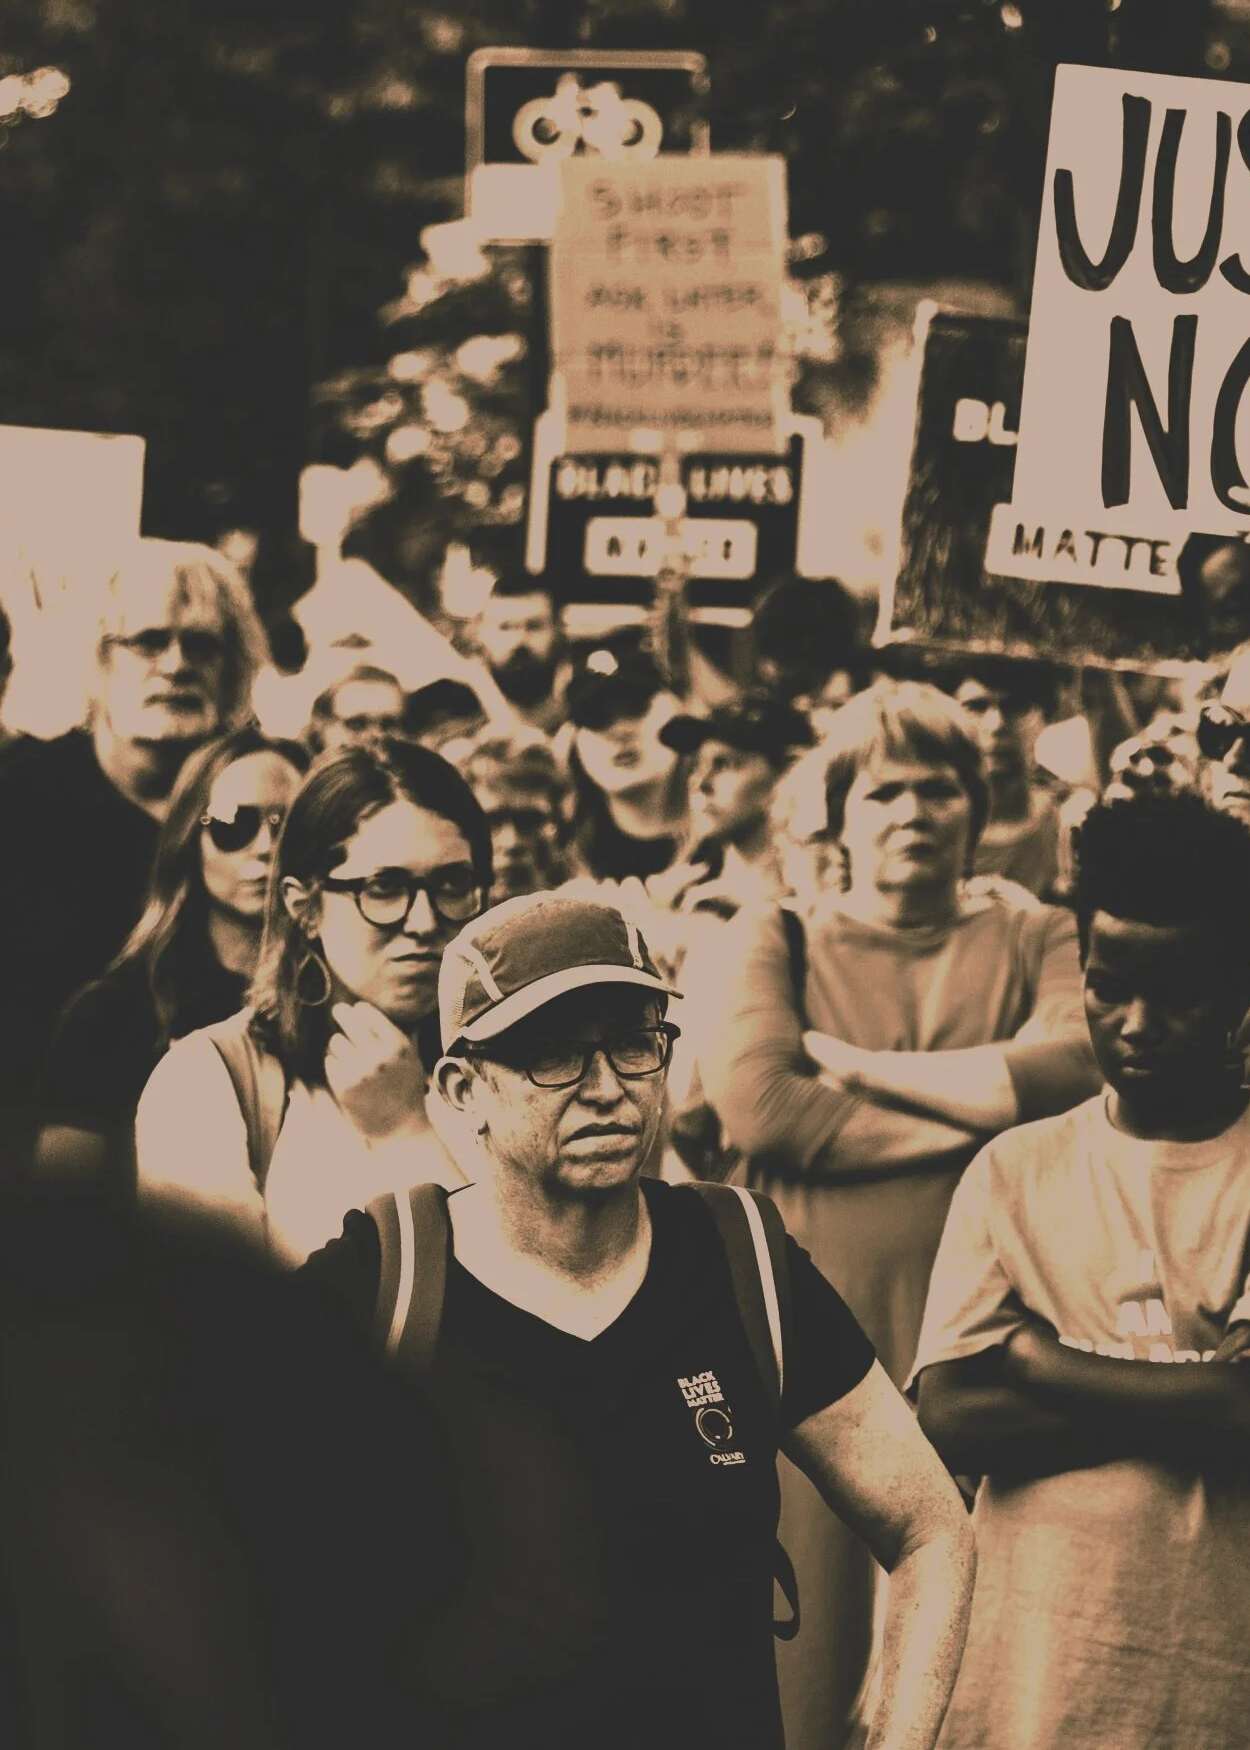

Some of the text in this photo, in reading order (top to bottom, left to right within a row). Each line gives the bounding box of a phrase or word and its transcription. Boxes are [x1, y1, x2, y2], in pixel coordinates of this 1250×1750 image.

[953, 397, 1018, 446] BL
[1011, 523, 1171, 577] MATTE
[677, 1370, 717, 1389] BLACK
[681, 1380, 722, 1400] LIVES
[686, 1392, 725, 1407] MATTER
